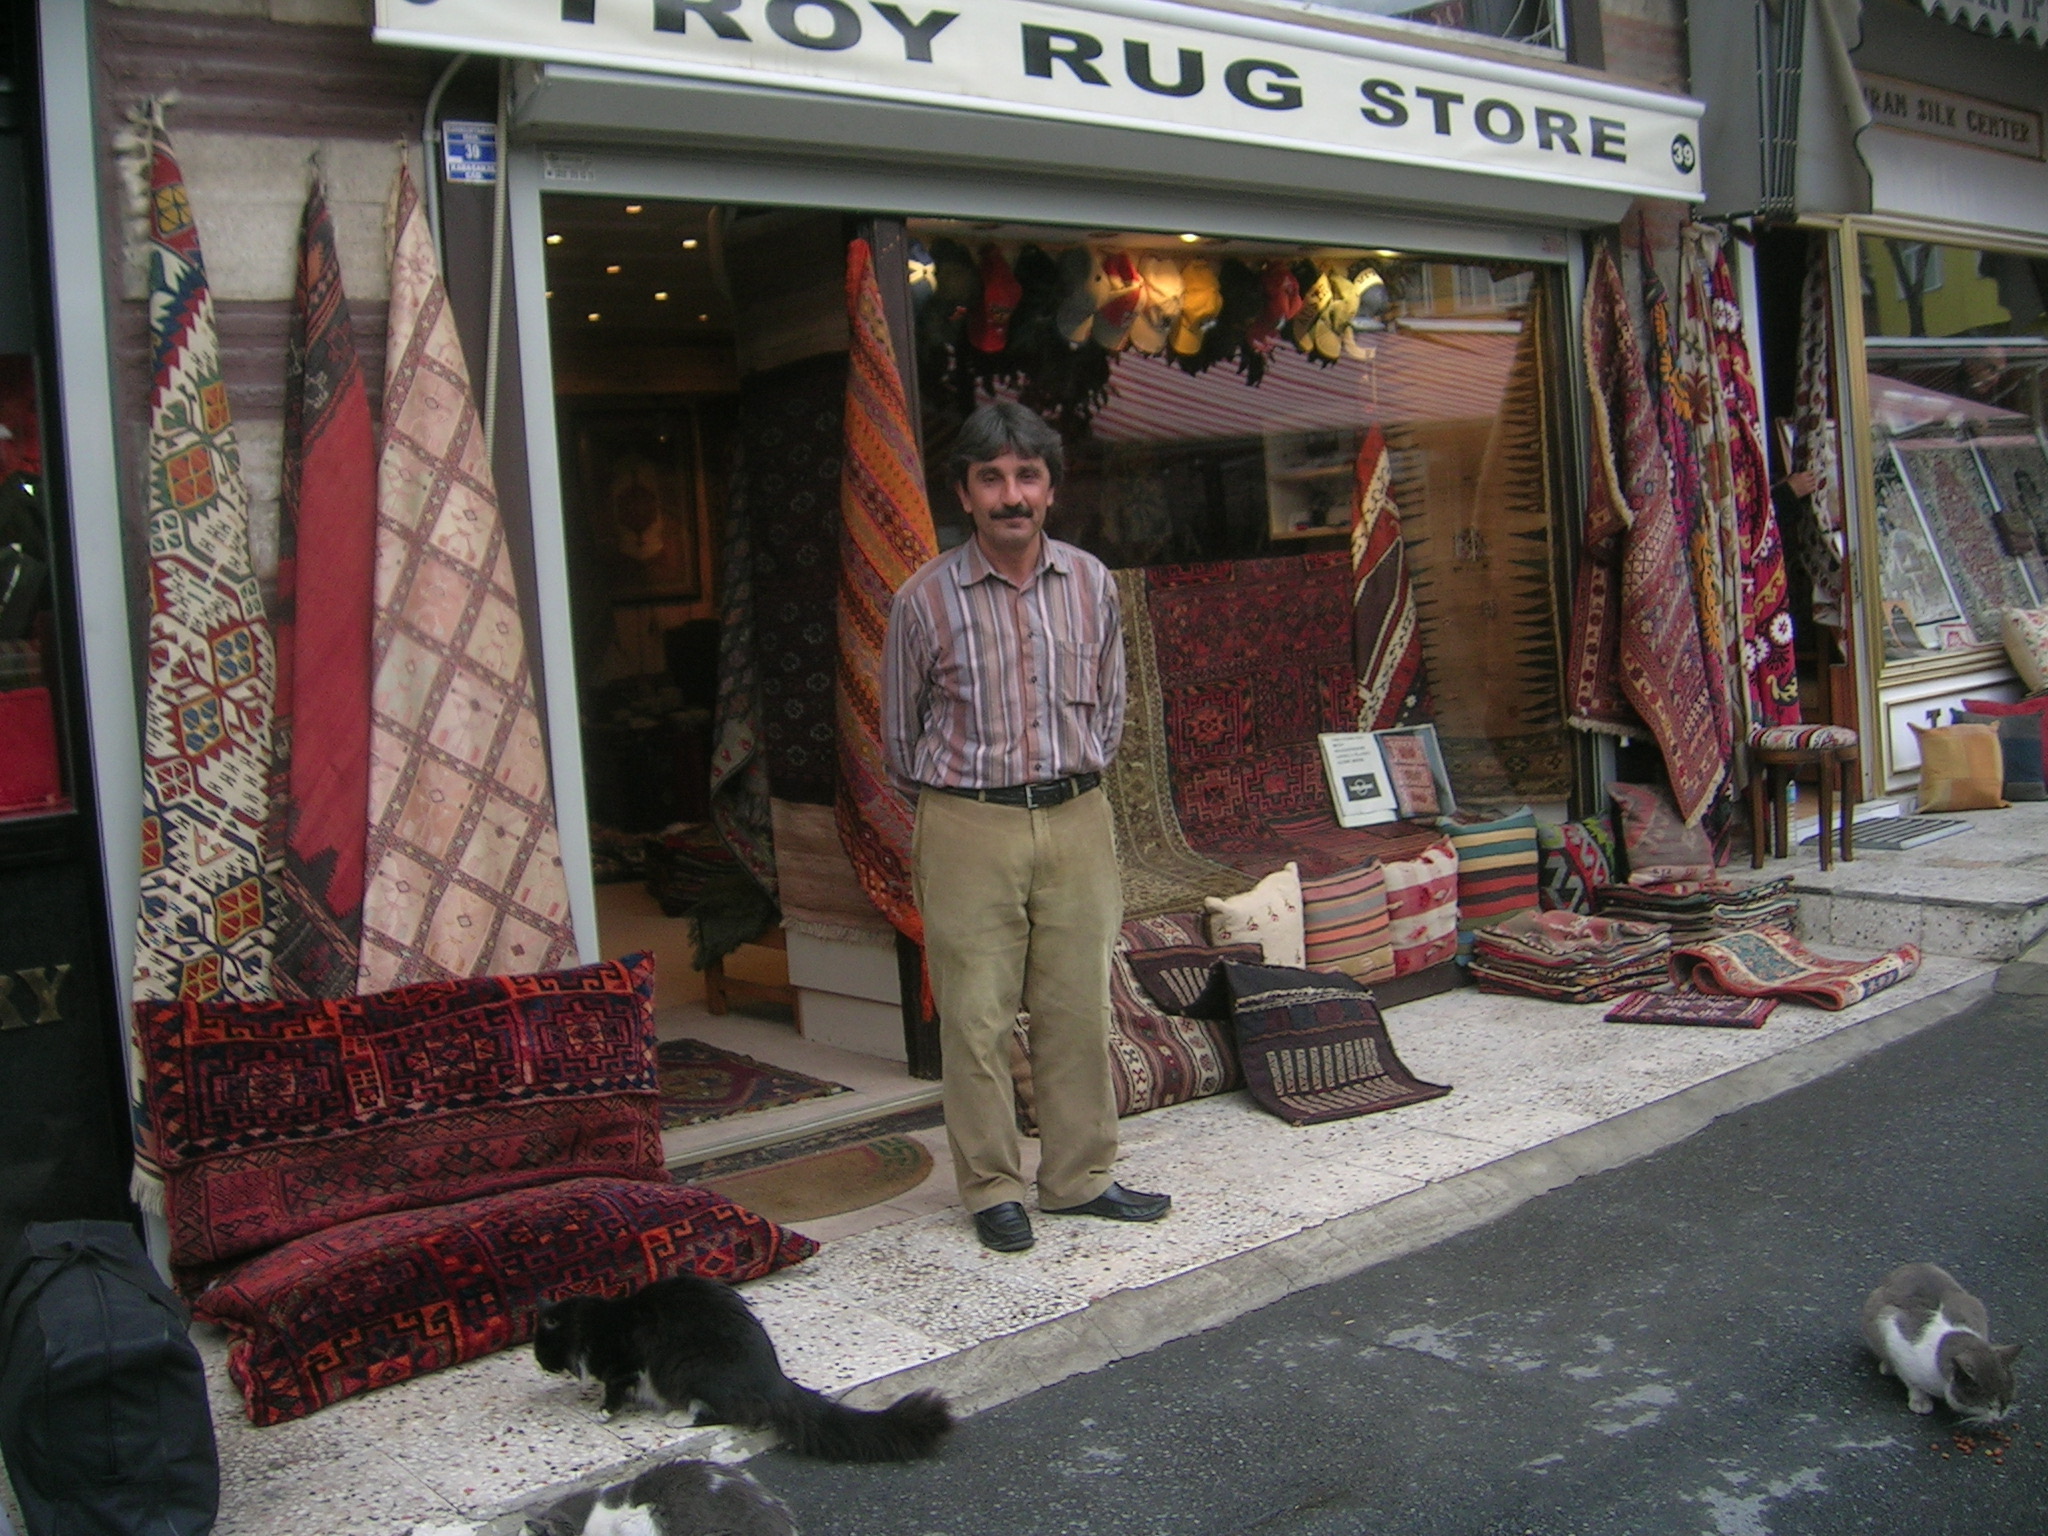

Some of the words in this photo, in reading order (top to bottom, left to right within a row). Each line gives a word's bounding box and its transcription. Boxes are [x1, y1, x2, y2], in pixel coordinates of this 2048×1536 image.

[1021, 22, 1303, 111] RUG
[1360, 78, 1627, 164] STORE
[1918, 98, 1956, 128] SILK
[1966, 109, 2030, 142] CENTER
[1672, 142, 1694, 167] 39
